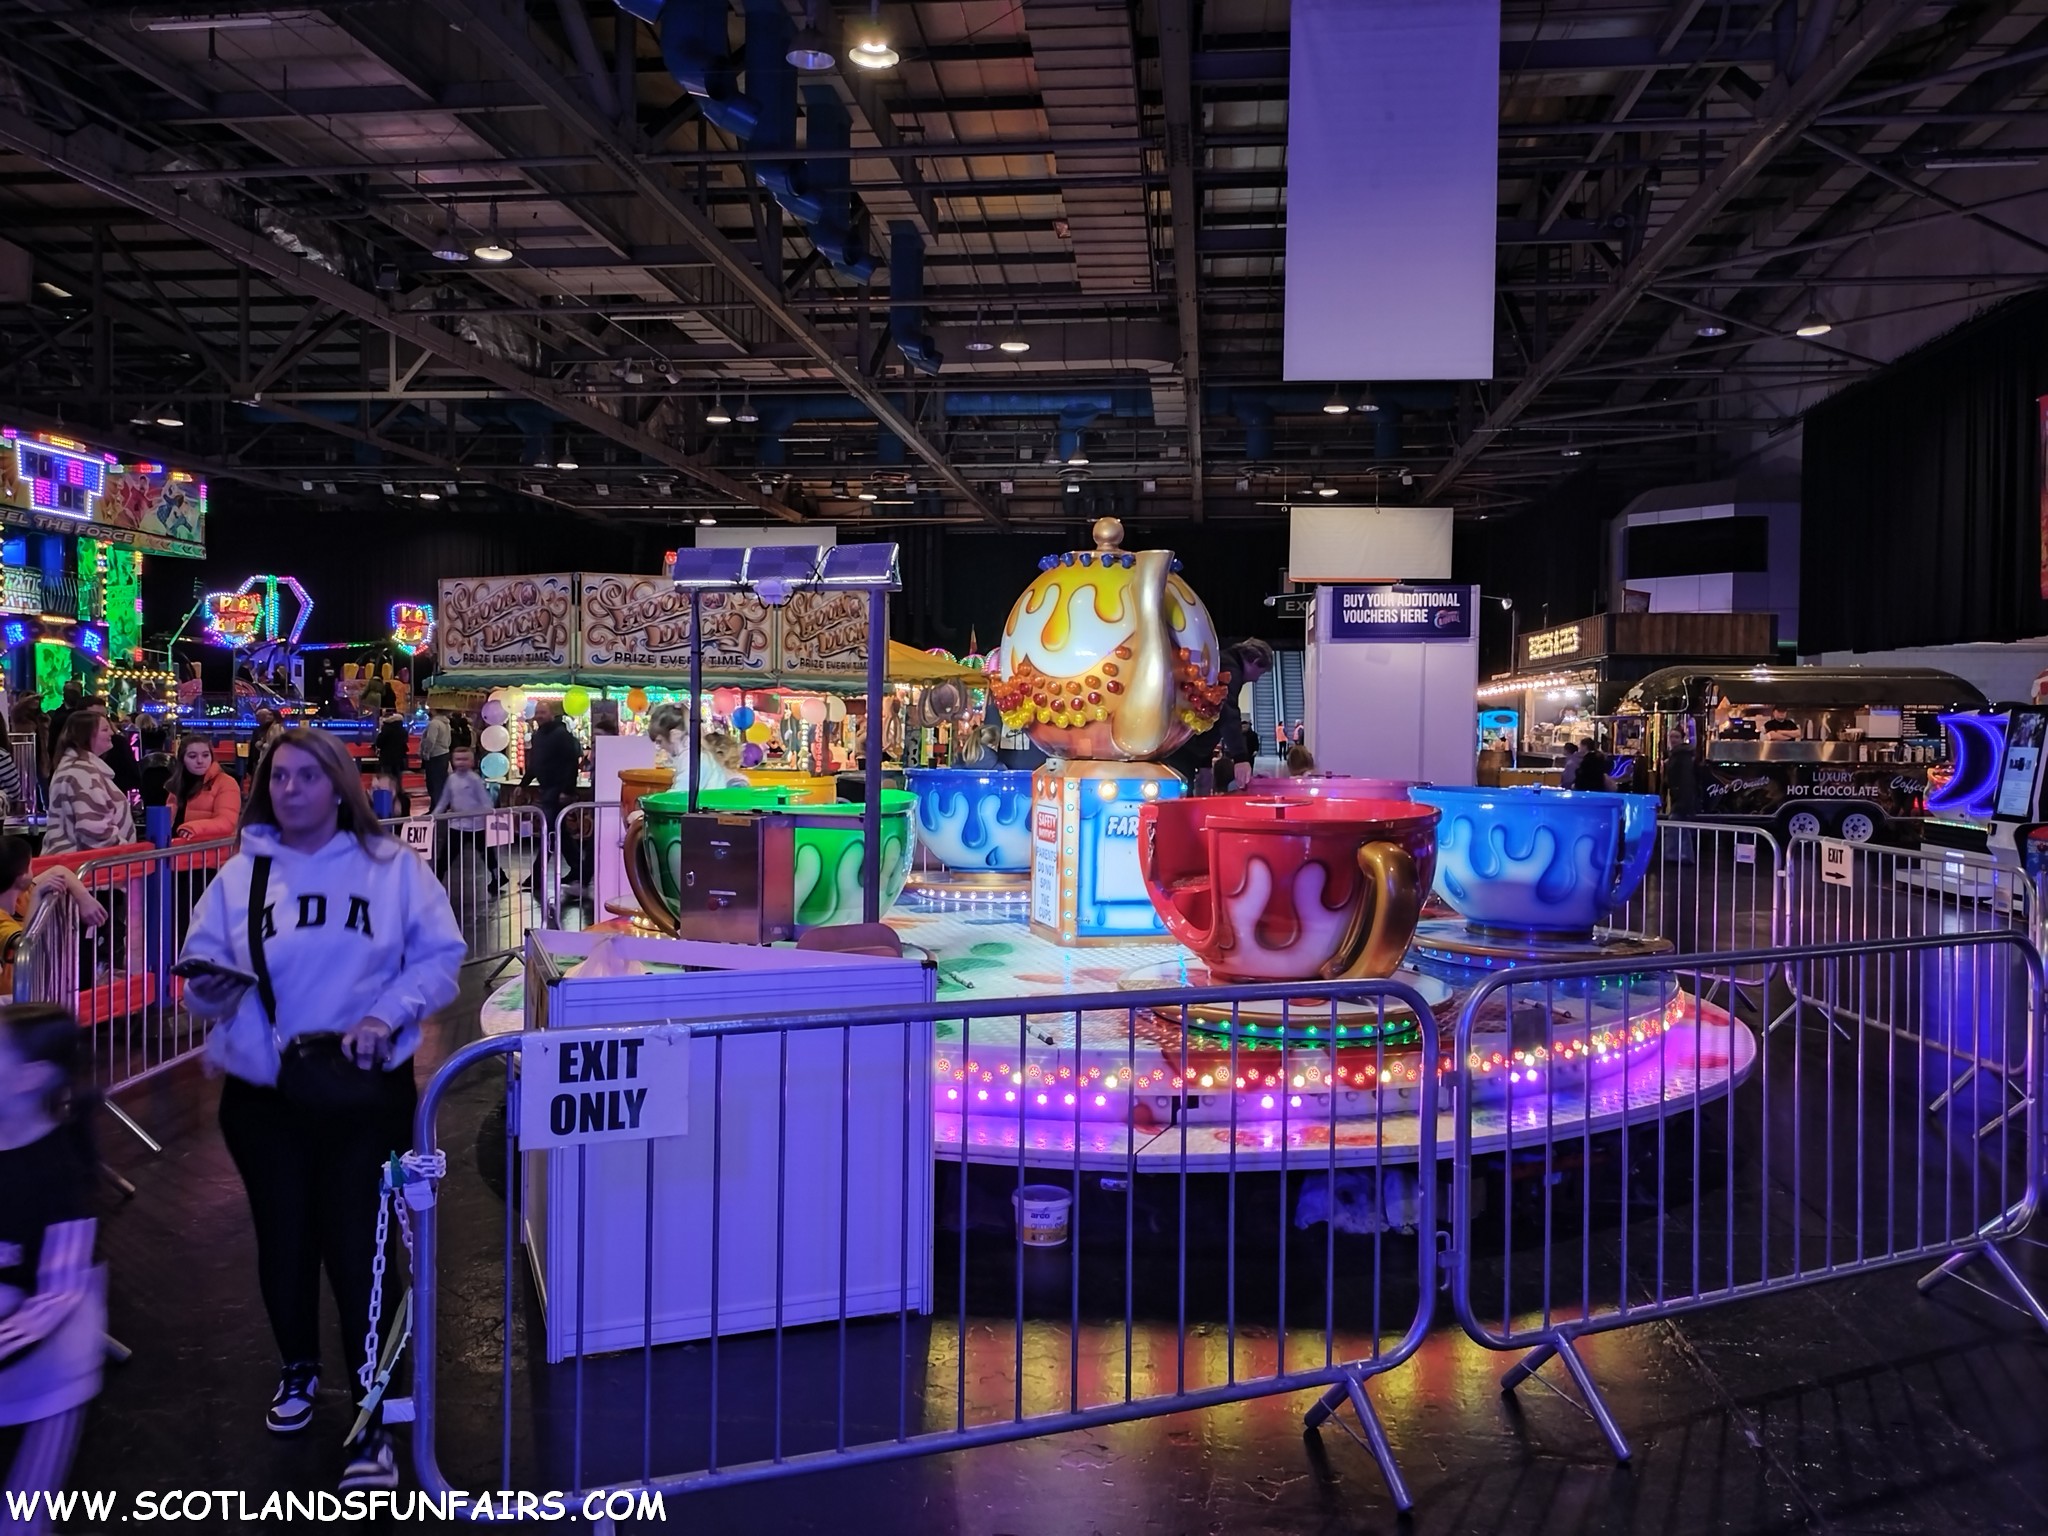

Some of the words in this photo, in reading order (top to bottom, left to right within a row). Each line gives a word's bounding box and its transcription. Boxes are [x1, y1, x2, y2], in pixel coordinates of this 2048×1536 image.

[34, 516, 72, 532] THE
[74, 523, 134, 544] FORCE
[1285, 600, 1306, 611] EX
[1343, 593, 1363, 607] BUY
[1367, 593, 1396, 607] YOUR
[1398, 592, 1460, 607] ADDITIONAL
[1343, 608, 1398, 623] VOUCHERS
[1400, 608, 1428, 623] HERE
[489, 609, 544, 645] DUCK
[658, 611, 734, 644] DUCK
[823, 622, 868, 650] DUCK
[463, 652, 490, 663] PRIZE
[493, 653, 521, 663] EVERY
[525, 652, 550, 662] TIME
[614, 651, 655, 664] PRIZE
[660, 655, 704, 665] EVER
[709, 655, 742, 666] TIME
[800, 657, 824, 668] PRIZE
[826, 659, 851, 669] EVERY
[852, 660, 869, 670] TIM
[1812, 772, 1853, 782] LUXURY
[1706, 783, 1730, 797] Hot
[1733, 776, 1771, 792] Donuts
[1786, 785, 1811, 796] HOT
[1812, 785, 1879, 797] CHOCOLATE
[1037, 812, 1056, 828] SAFETY
[1107, 815, 1139, 837] FAR
[407, 826, 428, 844] EXIT
[1036, 846, 1057, 863] PARENTS
[1827, 847, 1844, 865] EXIT
[1038, 861, 1045, 873] DO
[1045, 863, 1055, 878] NOT
[1040, 877, 1051, 891] SPIN
[1041, 893, 1050, 907] THE
[1038, 906, 1051, 922] CUPS
[559, 1038, 644, 1084] EXIT
[550, 1088, 648, 1136] ONLY
